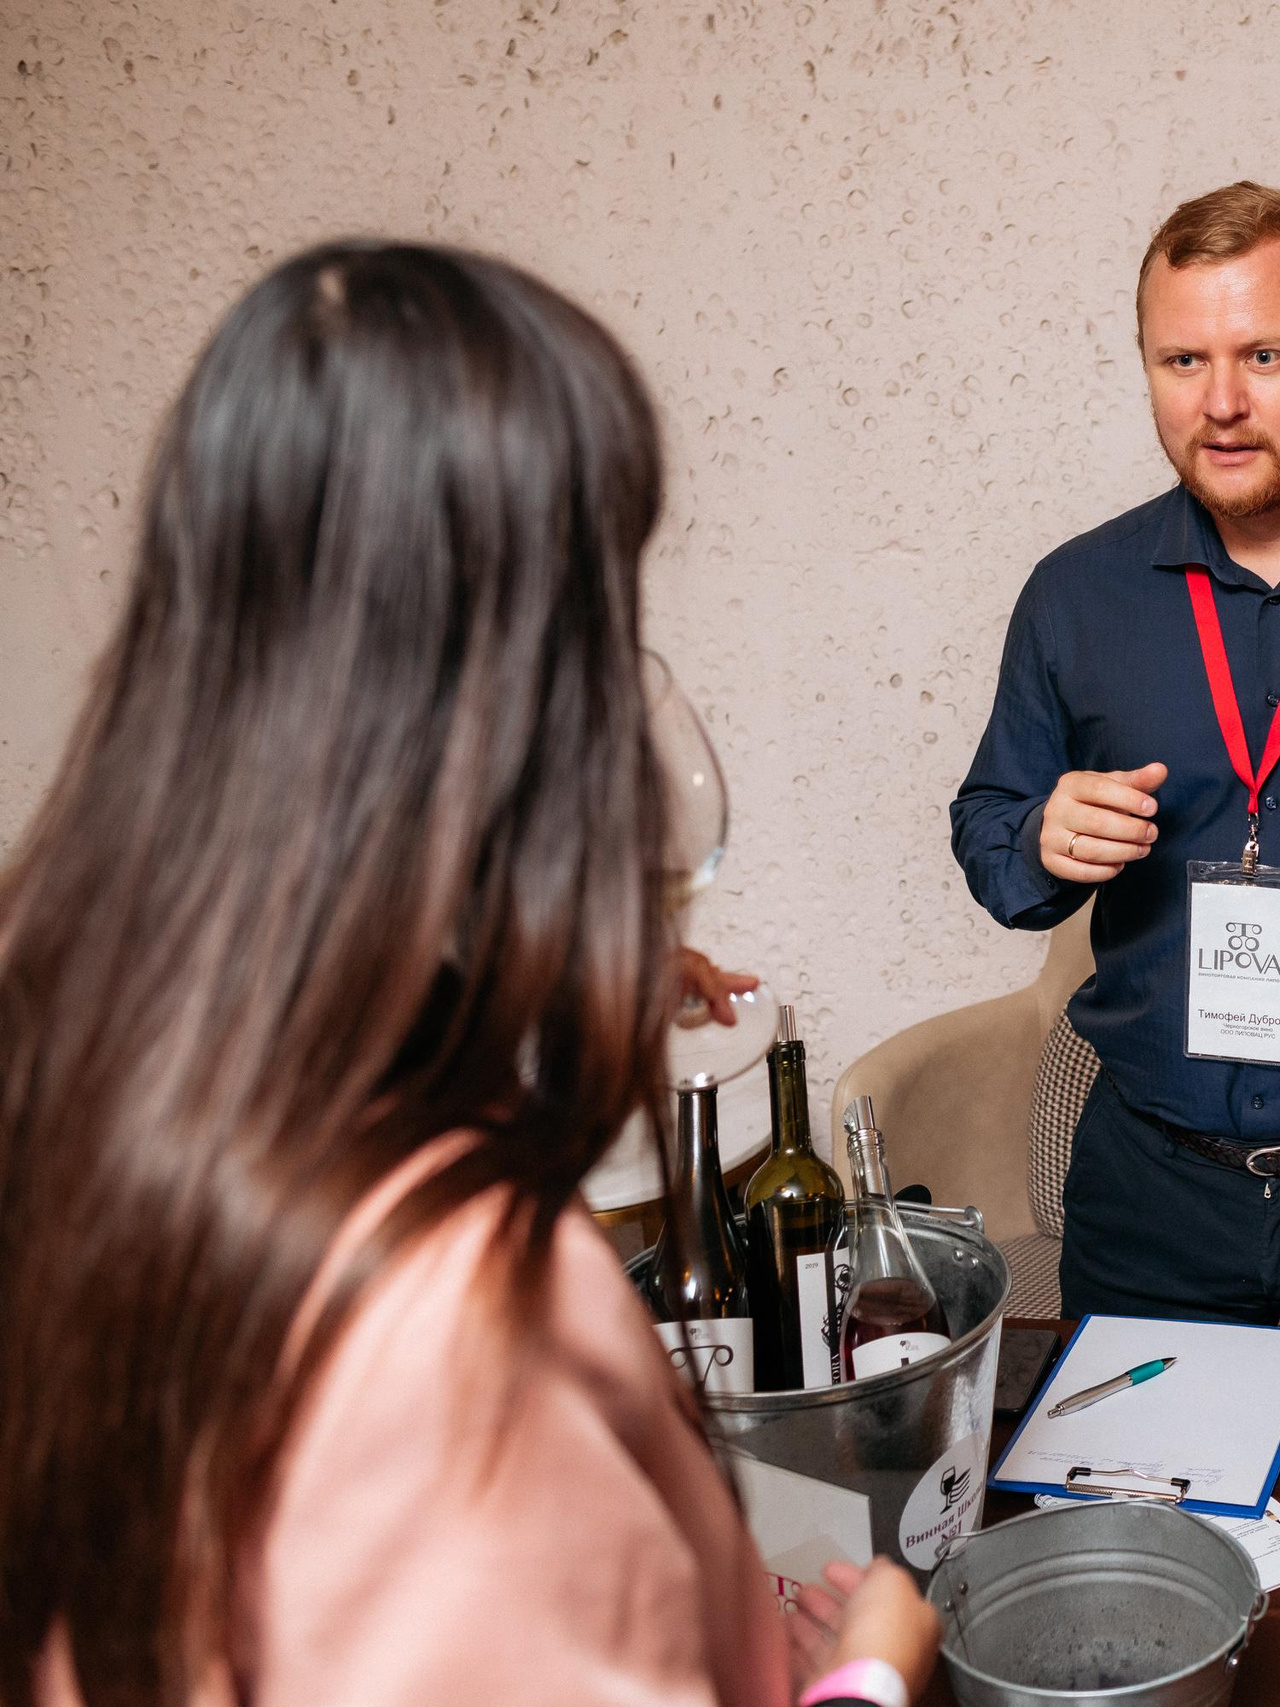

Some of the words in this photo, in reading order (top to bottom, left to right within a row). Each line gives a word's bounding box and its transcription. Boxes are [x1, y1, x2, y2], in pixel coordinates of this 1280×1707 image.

[1198, 1009, 1246, 1022] Тимофей
[1234, 1029, 1263, 1039] ЛИПОВАЦ
[1263, 1032, 1276, 1040] РУС
[805, 1262, 819, 1270] 2019
[905, 1514, 955, 1549] Винная
